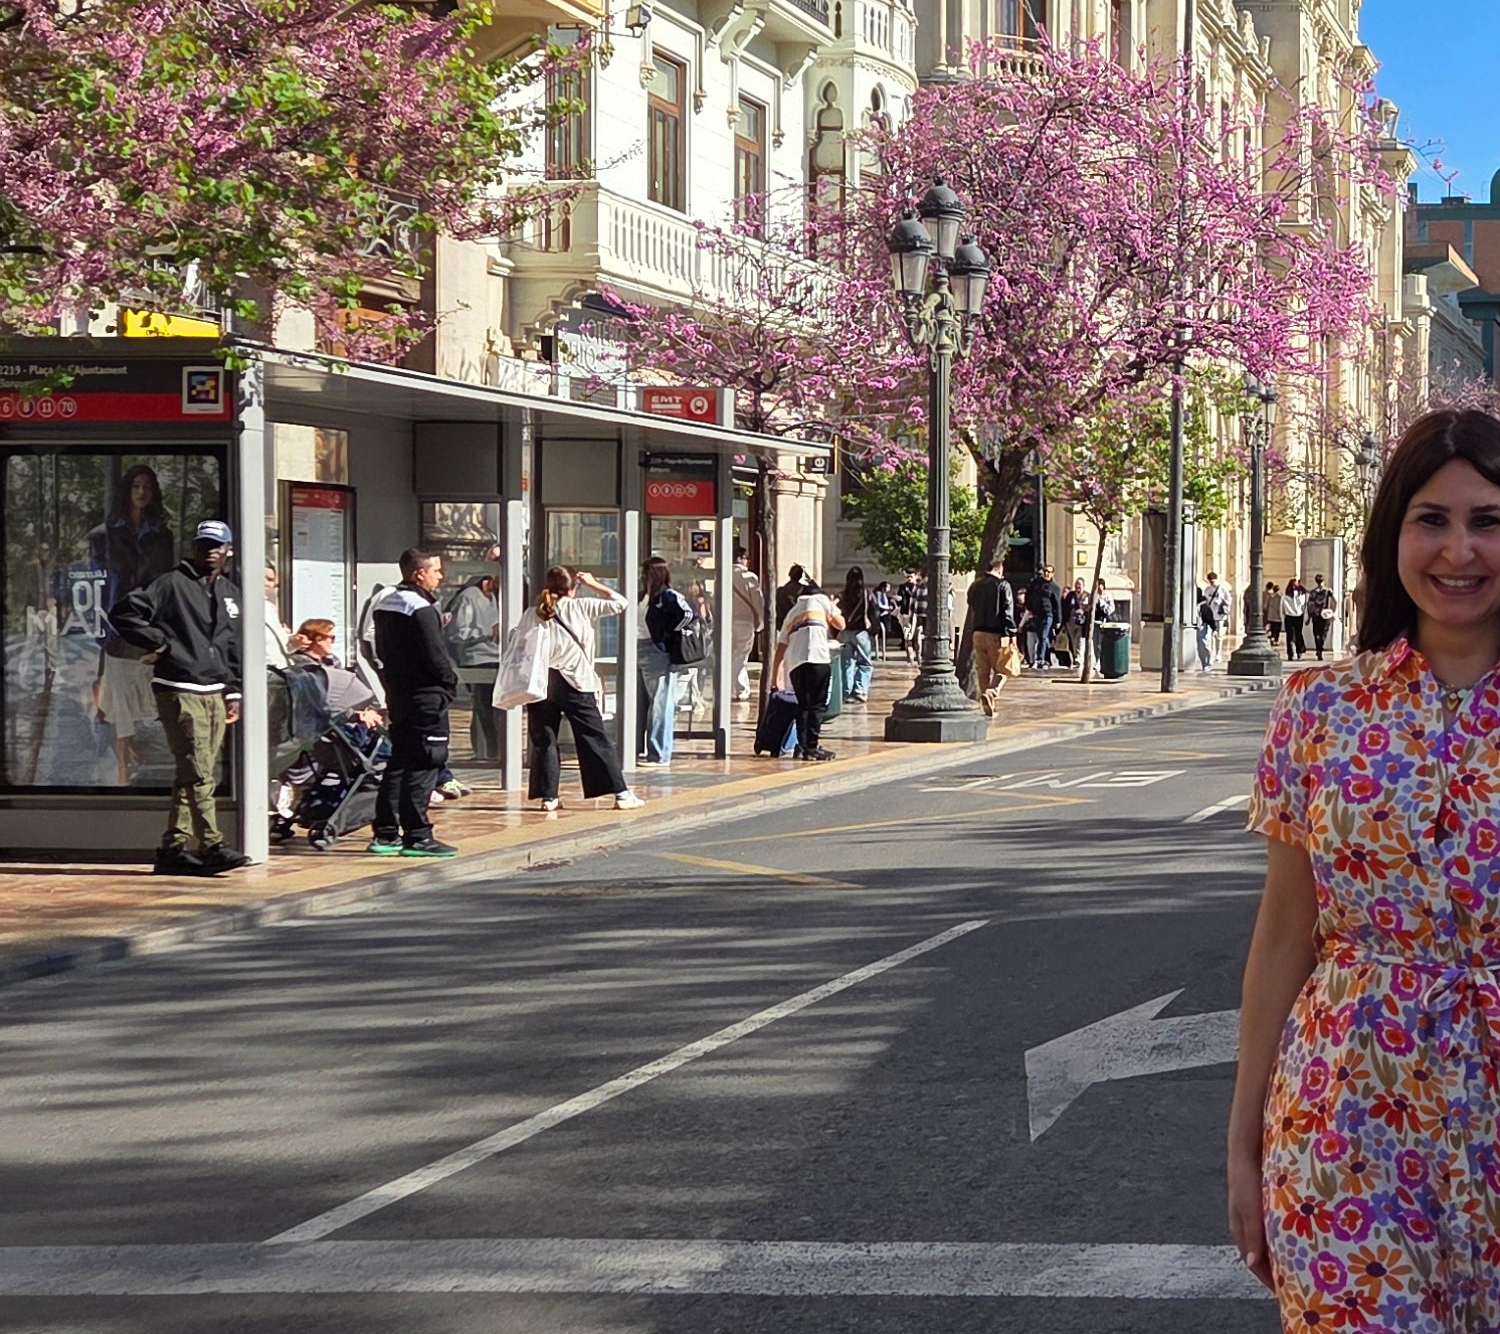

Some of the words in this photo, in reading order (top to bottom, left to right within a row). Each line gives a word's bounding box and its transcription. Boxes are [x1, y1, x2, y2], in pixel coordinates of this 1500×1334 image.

[42, 402, 52, 413] 11
[62, 402, 74, 413] 70
[919, 769, 1187, 793] EMT
